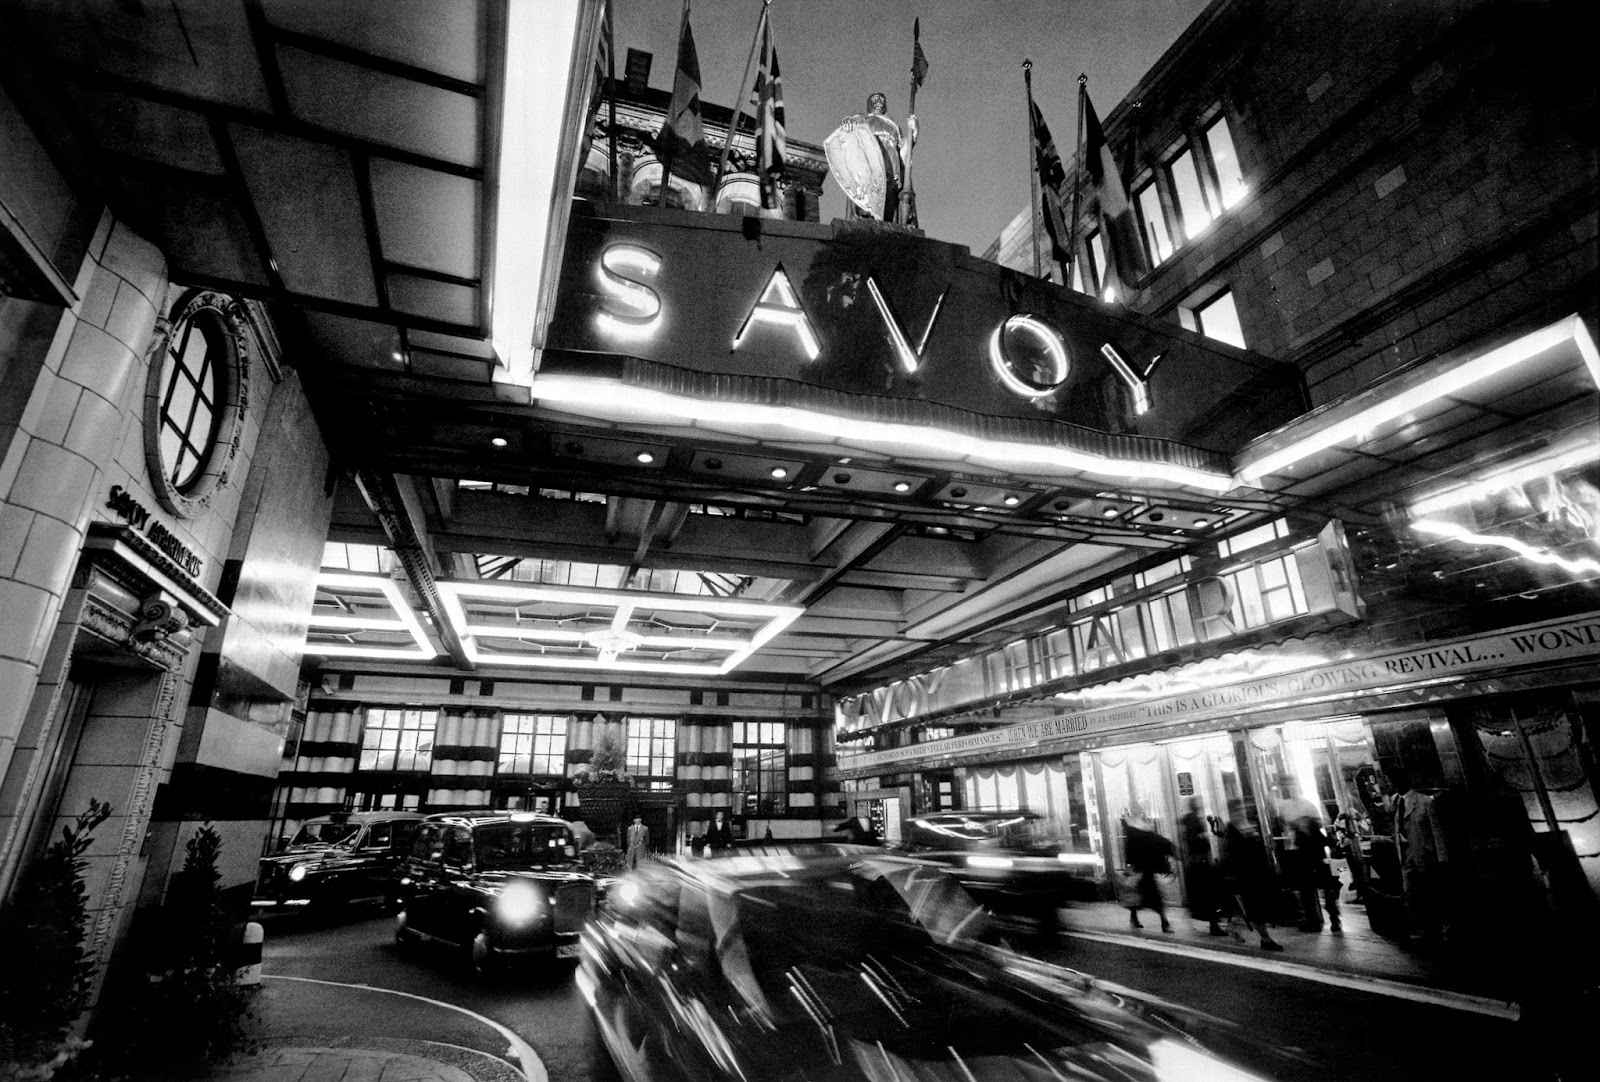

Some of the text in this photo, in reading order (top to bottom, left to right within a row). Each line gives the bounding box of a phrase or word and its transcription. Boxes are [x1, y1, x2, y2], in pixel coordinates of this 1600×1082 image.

[597, 243, 1168, 416] SAVOY
[1176, 700, 1188, 712] IS
[1191, 698, 1199, 710] A
[1288, 663, 1377, 693] GLOWING
[1510, 624, 1600, 654] WOND
[1007, 727, 1026, 742] WHEN
[1027, 724, 1040, 739] WE
[1040, 721, 1054, 737] ARE
[1055, 715, 1088, 735] MARRIED
